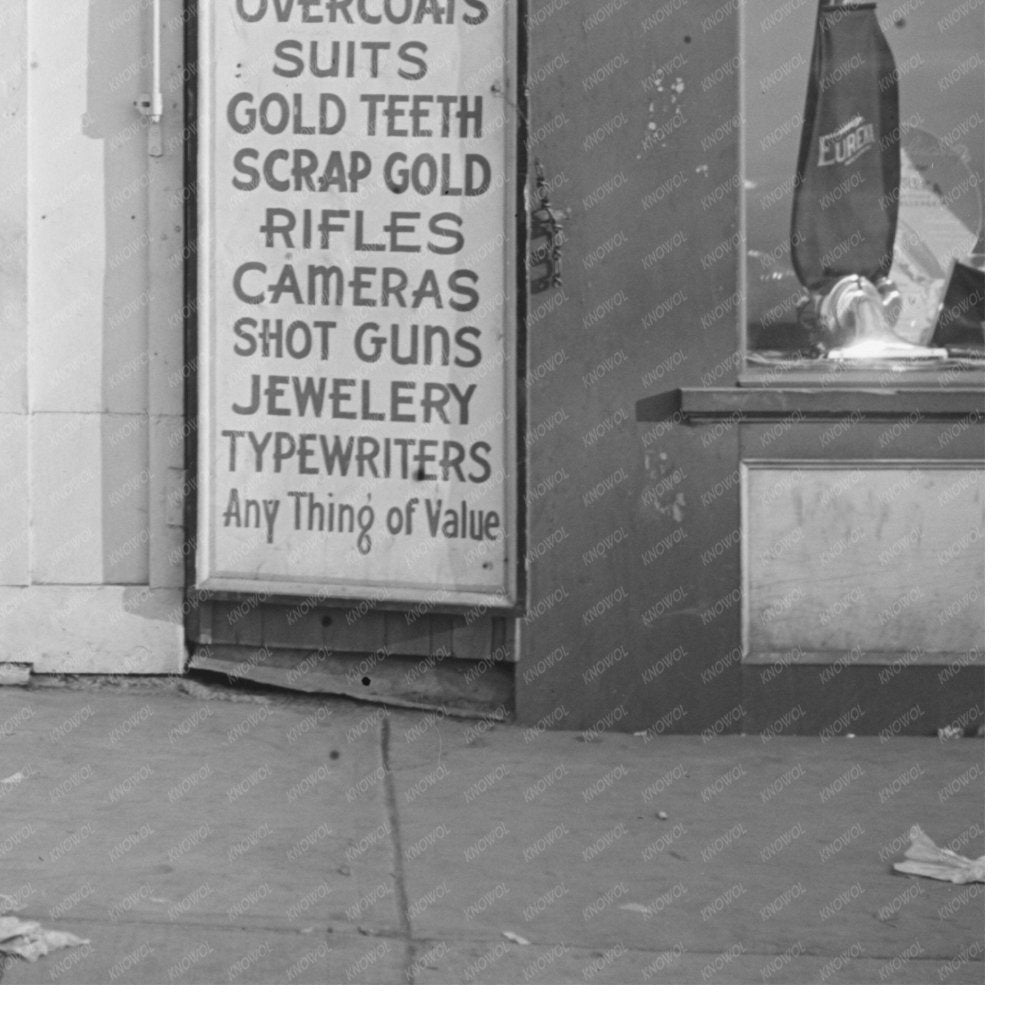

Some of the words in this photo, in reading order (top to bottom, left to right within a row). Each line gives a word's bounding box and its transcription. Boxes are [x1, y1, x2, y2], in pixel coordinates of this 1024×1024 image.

[272, 39, 429, 81] SUITS
[226, 92, 347, 136] GOLD
[360, 94, 483, 139] TEETH
[231, 148, 373, 193] SCRAP
[383, 152, 492, 197] GOLD
[260, 207, 466, 255] RIFLES
[232, 261, 480, 313] CAMERAS
[232, 317, 337, 361] SHOT
[354, 321, 483, 368] GUNS
[231, 374, 477, 426] JEWELERY
[221, 430, 493, 484] TYPEWRITERS
[223, 488, 280, 544] Any
[287, 491, 375, 555] Thing
[386, 497, 419, 535] of
[425, 497, 500, 542] Value
